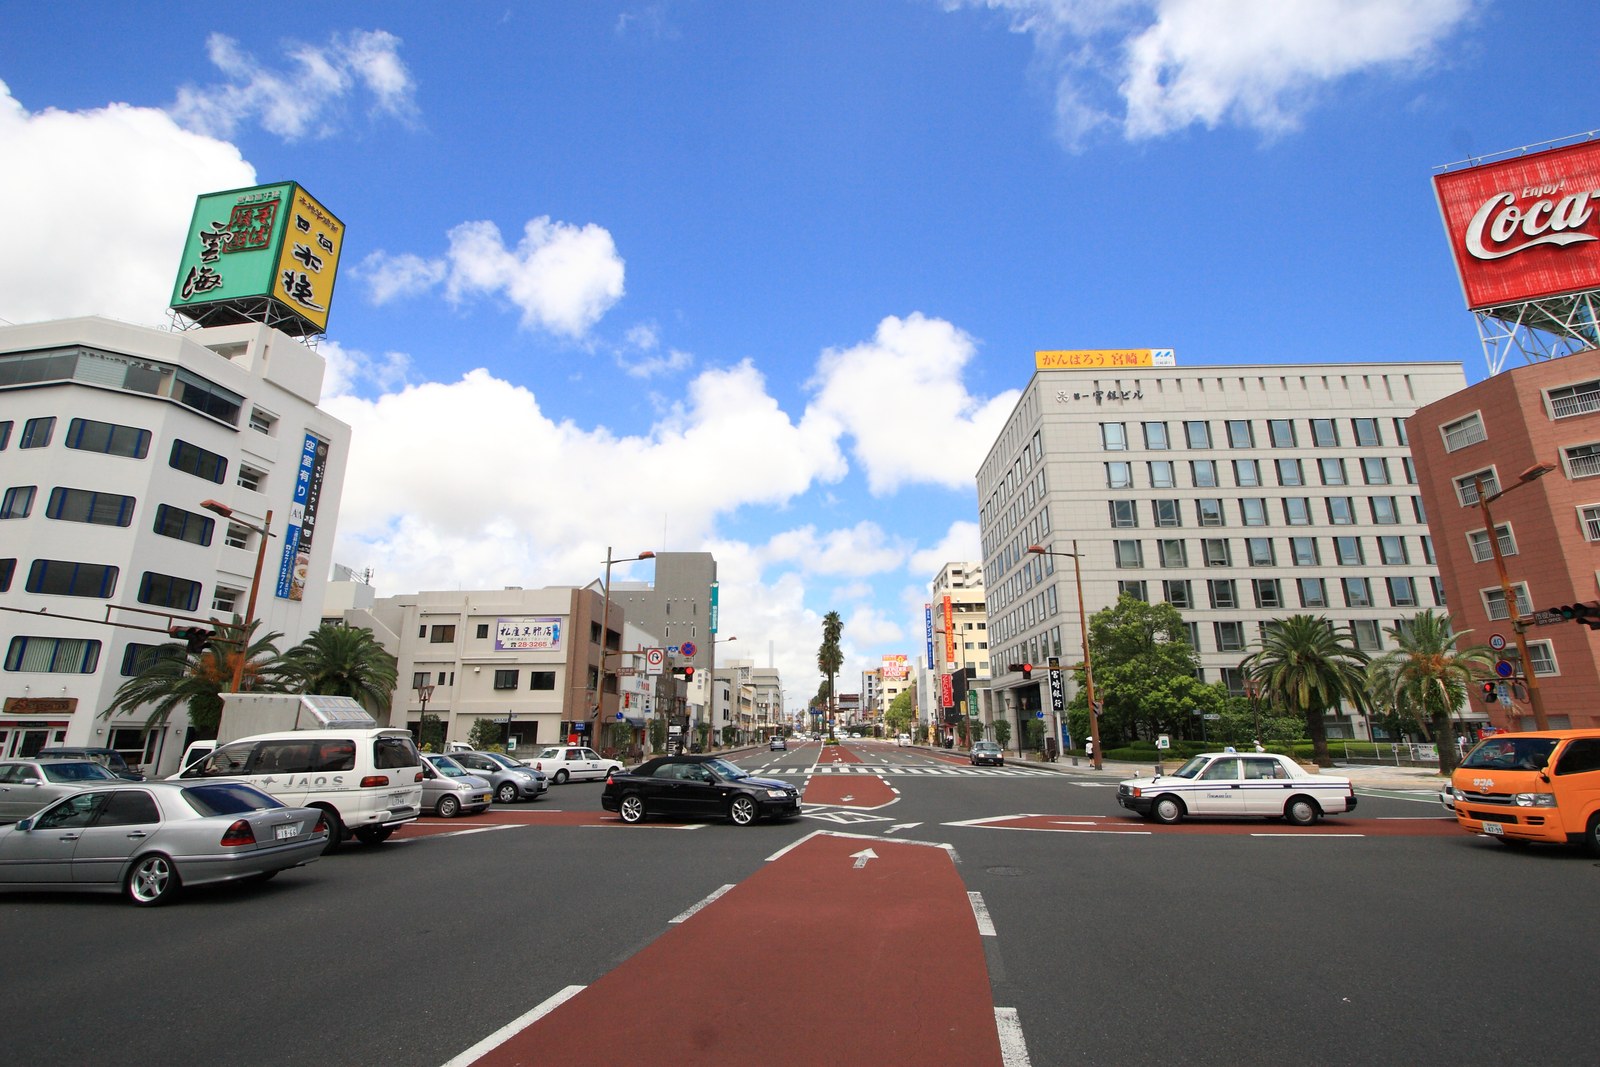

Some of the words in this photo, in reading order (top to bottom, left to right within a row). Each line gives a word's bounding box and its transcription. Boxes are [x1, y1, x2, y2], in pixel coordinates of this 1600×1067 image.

[1521, 180, 1565, 199] Enjoy!
[180, 221, 234, 301] 雲海
[1042, 353, 1106, 366] がんばろう
[297, 439, 316, 497] 空室有り
[1492, 638, 1504, 647] 40
[284, 775, 344, 788] JAOS
